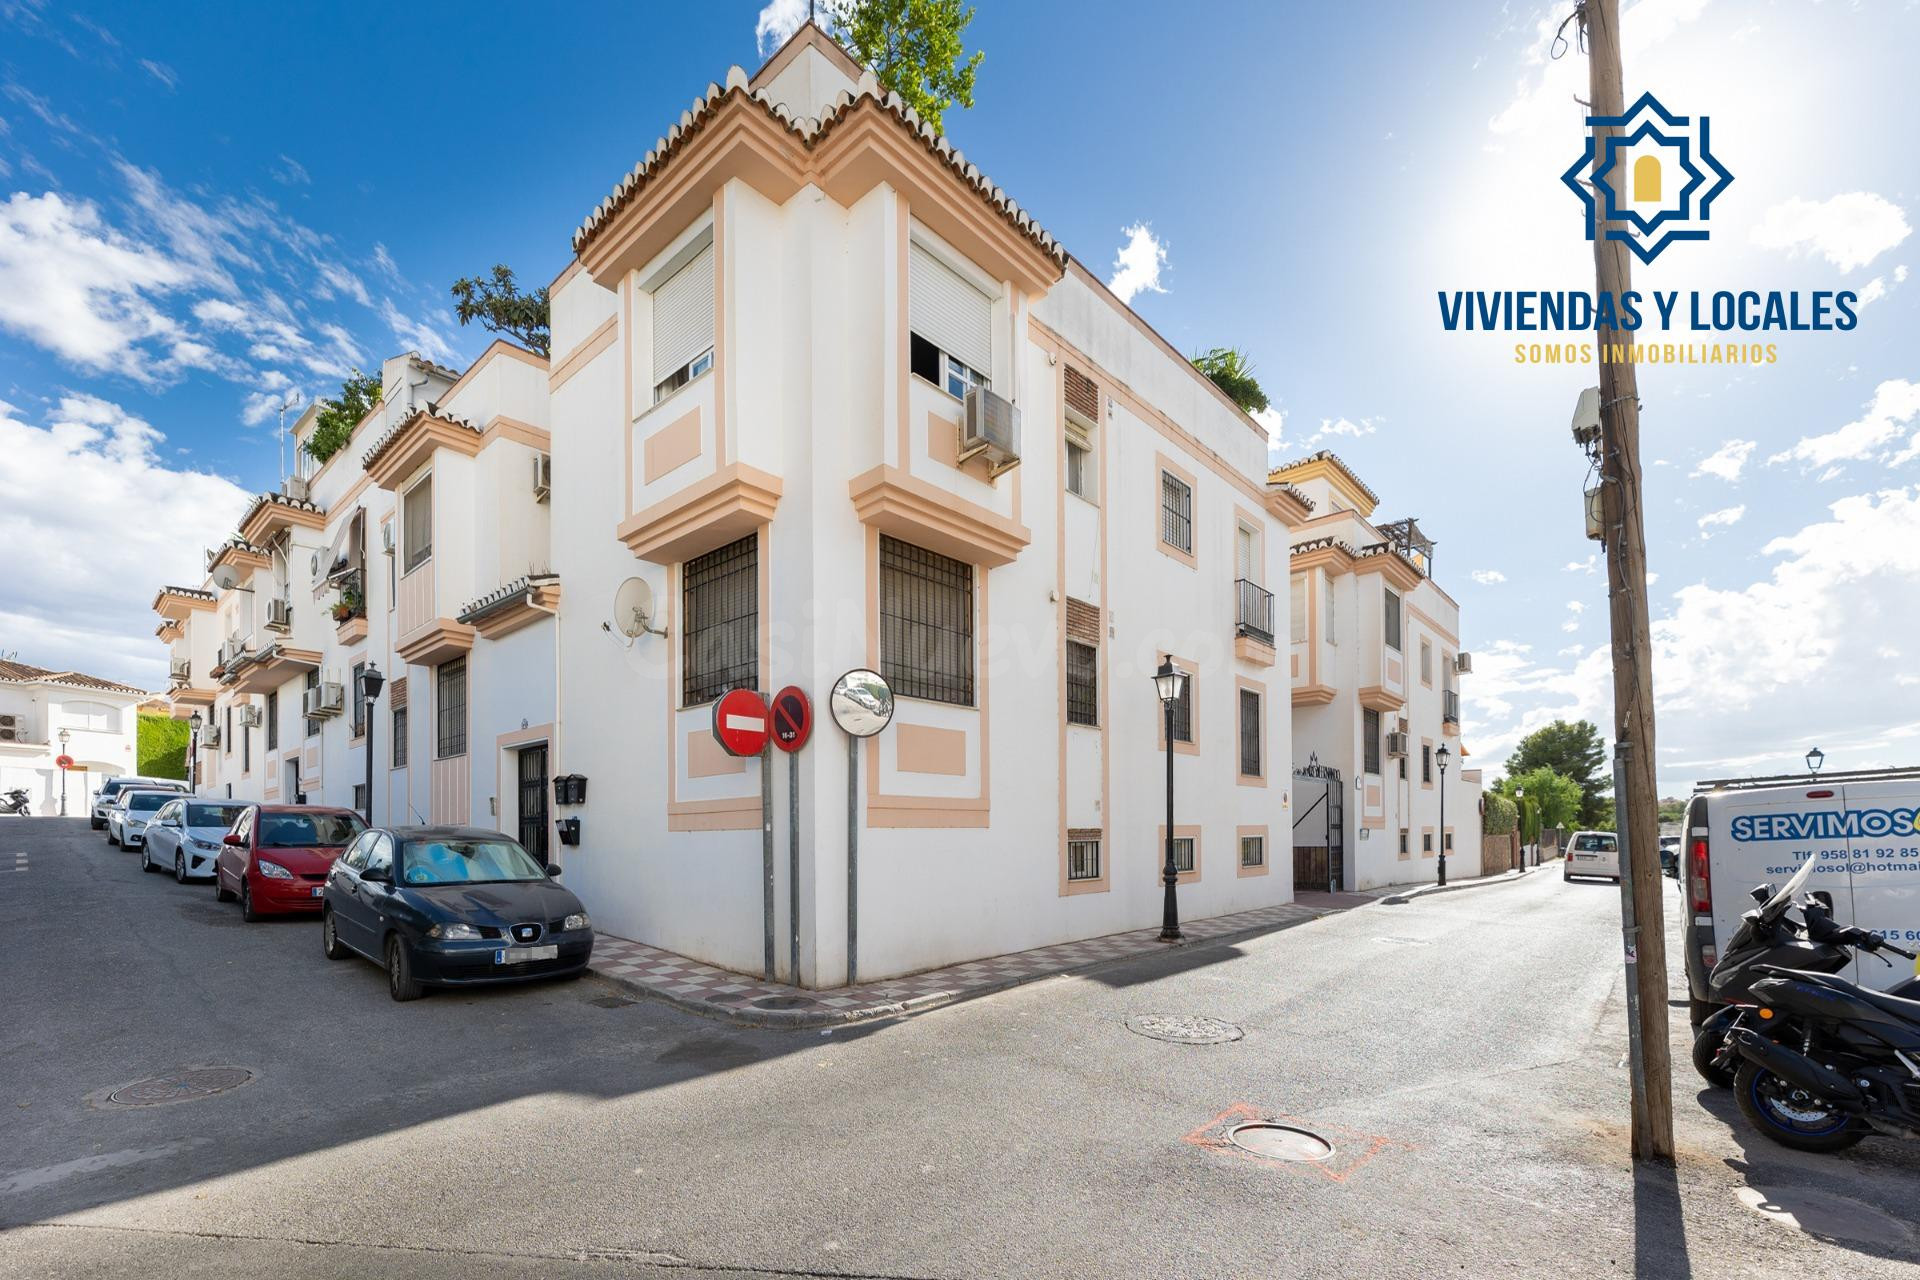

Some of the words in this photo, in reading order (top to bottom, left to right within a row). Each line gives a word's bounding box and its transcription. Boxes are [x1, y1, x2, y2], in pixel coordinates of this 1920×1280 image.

[1732, 808, 1920, 841] SERVIMOS
[1820, 850, 1848, 860] 958
[1853, 848, 1869, 859] 81
[1876, 848, 1894, 858] 92
[1900, 847, 1919, 858] 85
